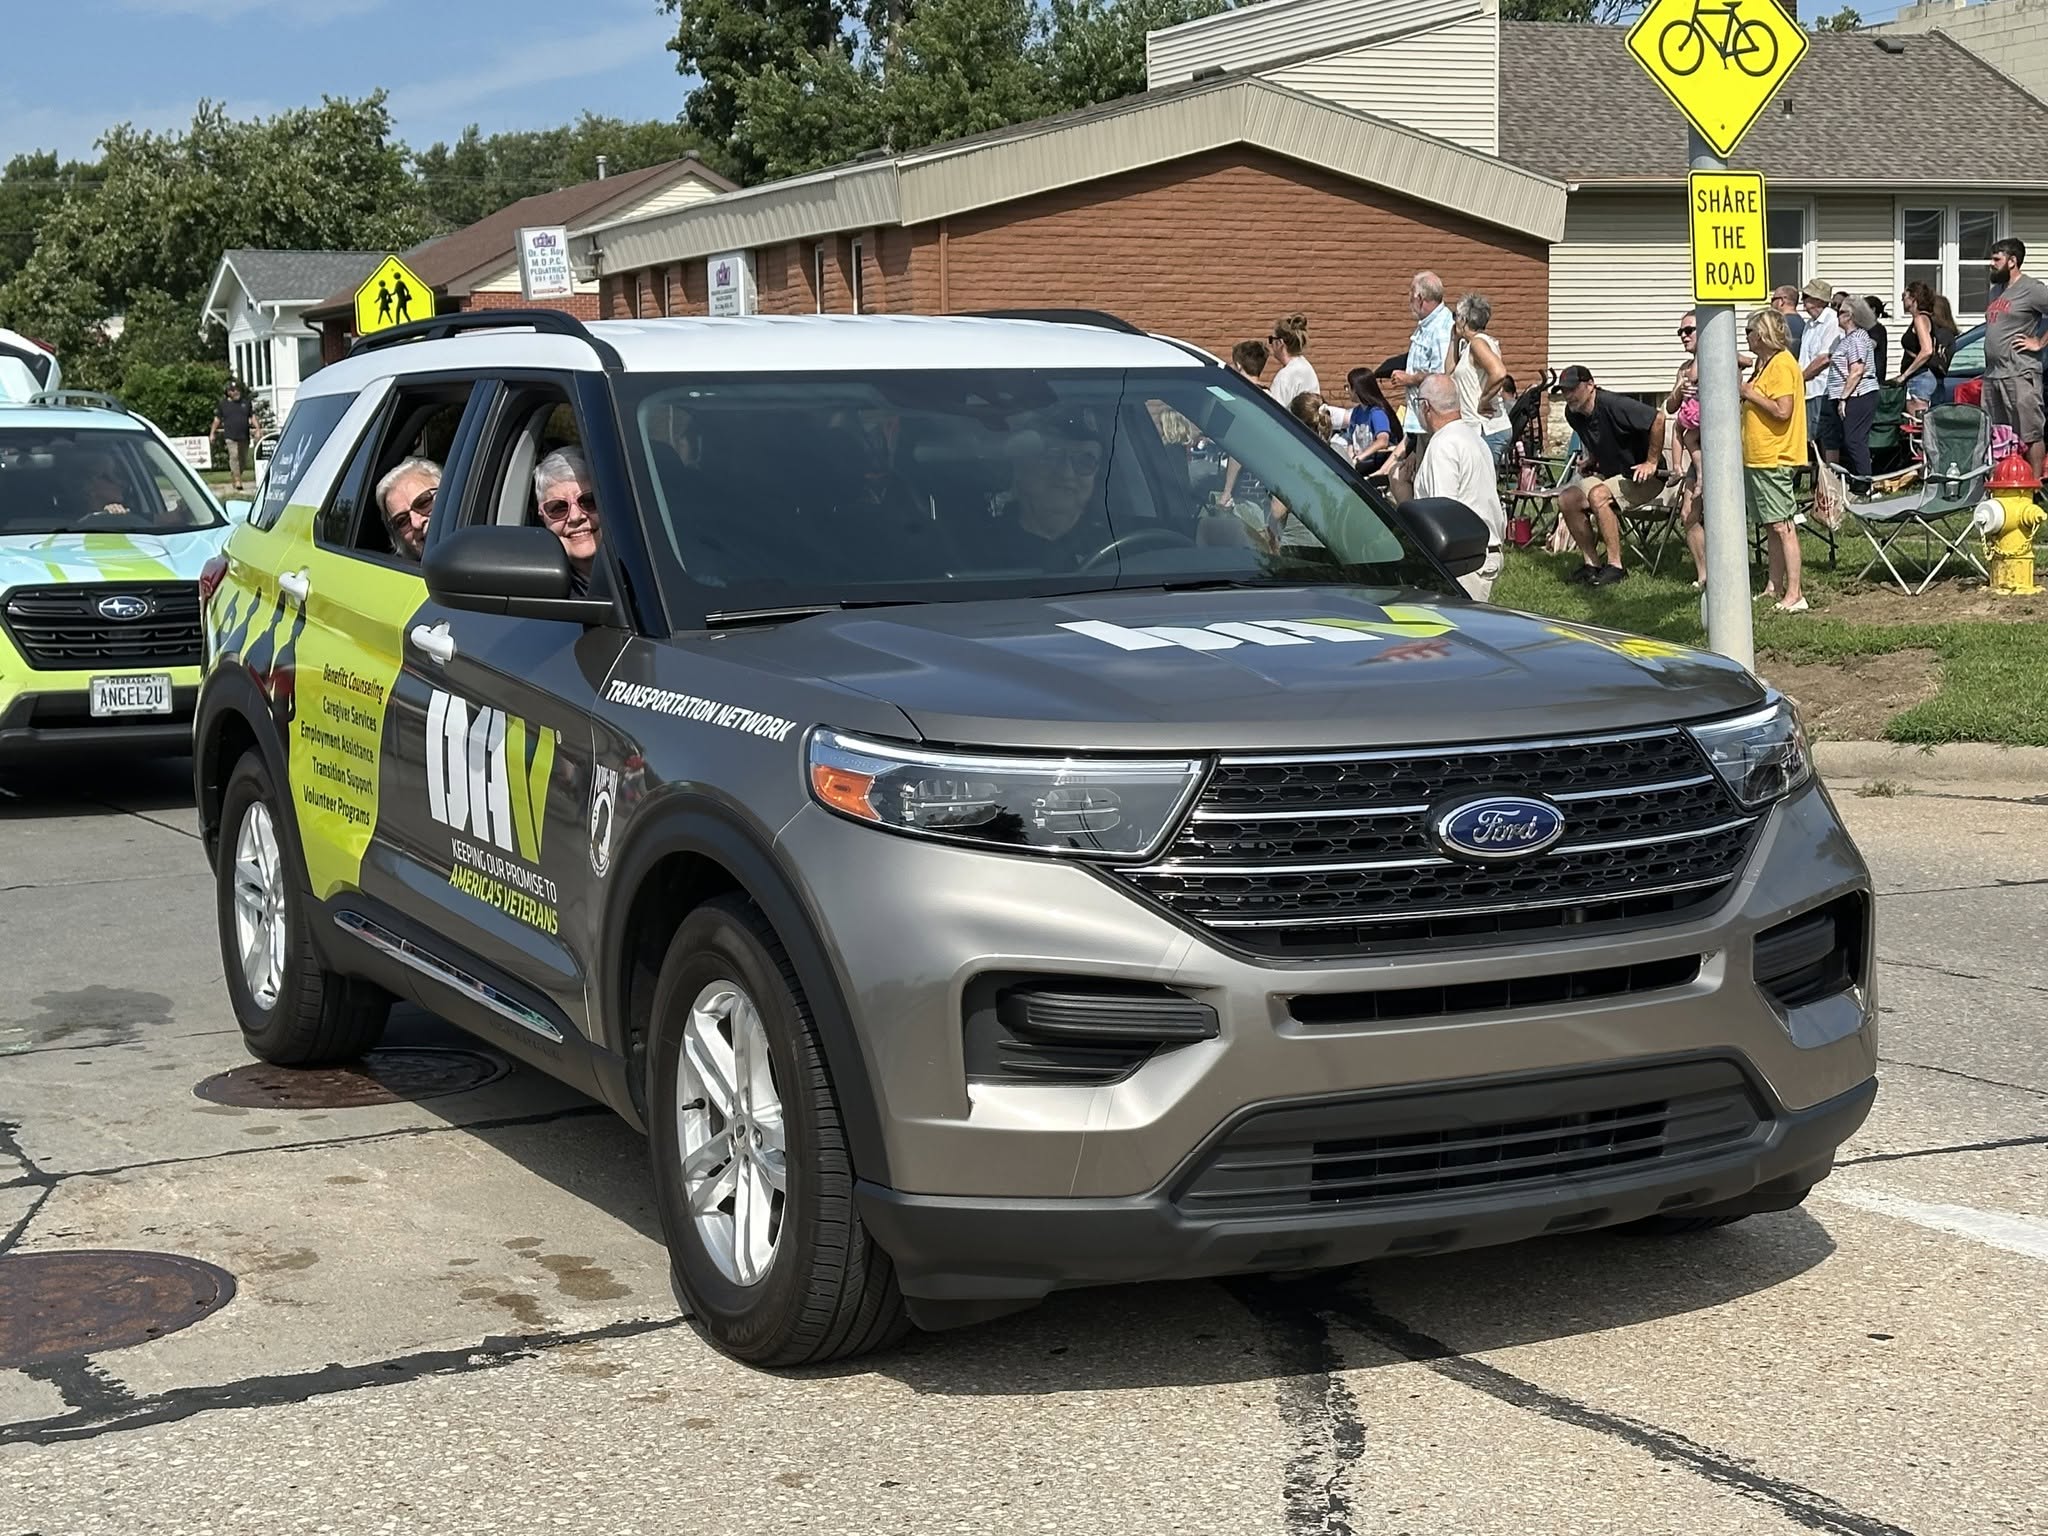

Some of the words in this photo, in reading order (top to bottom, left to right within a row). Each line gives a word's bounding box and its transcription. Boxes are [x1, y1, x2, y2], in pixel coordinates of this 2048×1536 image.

[1697, 189, 1758, 213] SHARE
[1711, 226, 1746, 249] THE
[1706, 262, 1755, 285] ROAD
[101, 686, 162, 707] ANGEL2U
[323, 663, 348, 688] Benefits
[349, 672, 384, 705] Counseling
[323, 696, 350, 723] Caregiver
[351, 706, 377, 732] Services
[605, 679, 721, 723] TRANSPORTATION
[713, 704, 797, 742] NETWORK
[301, 720, 341, 750] Employment
[341, 735, 374, 764] Assistance
[312, 756, 345, 784] Transition
[347, 768, 374, 796] Support
[303, 784, 337, 812] Volunteer
[337, 797, 370, 826] Programs
[1473, 809, 1538, 843] Ford
[451, 837, 486, 871] KEEPING
[486, 853, 506, 879] OUR
[505, 861, 544, 898] PROMISE
[544, 879, 557, 904] TO
[448, 863, 502, 908] AMERICA'S
[503, 886, 558, 935] VETERANS
